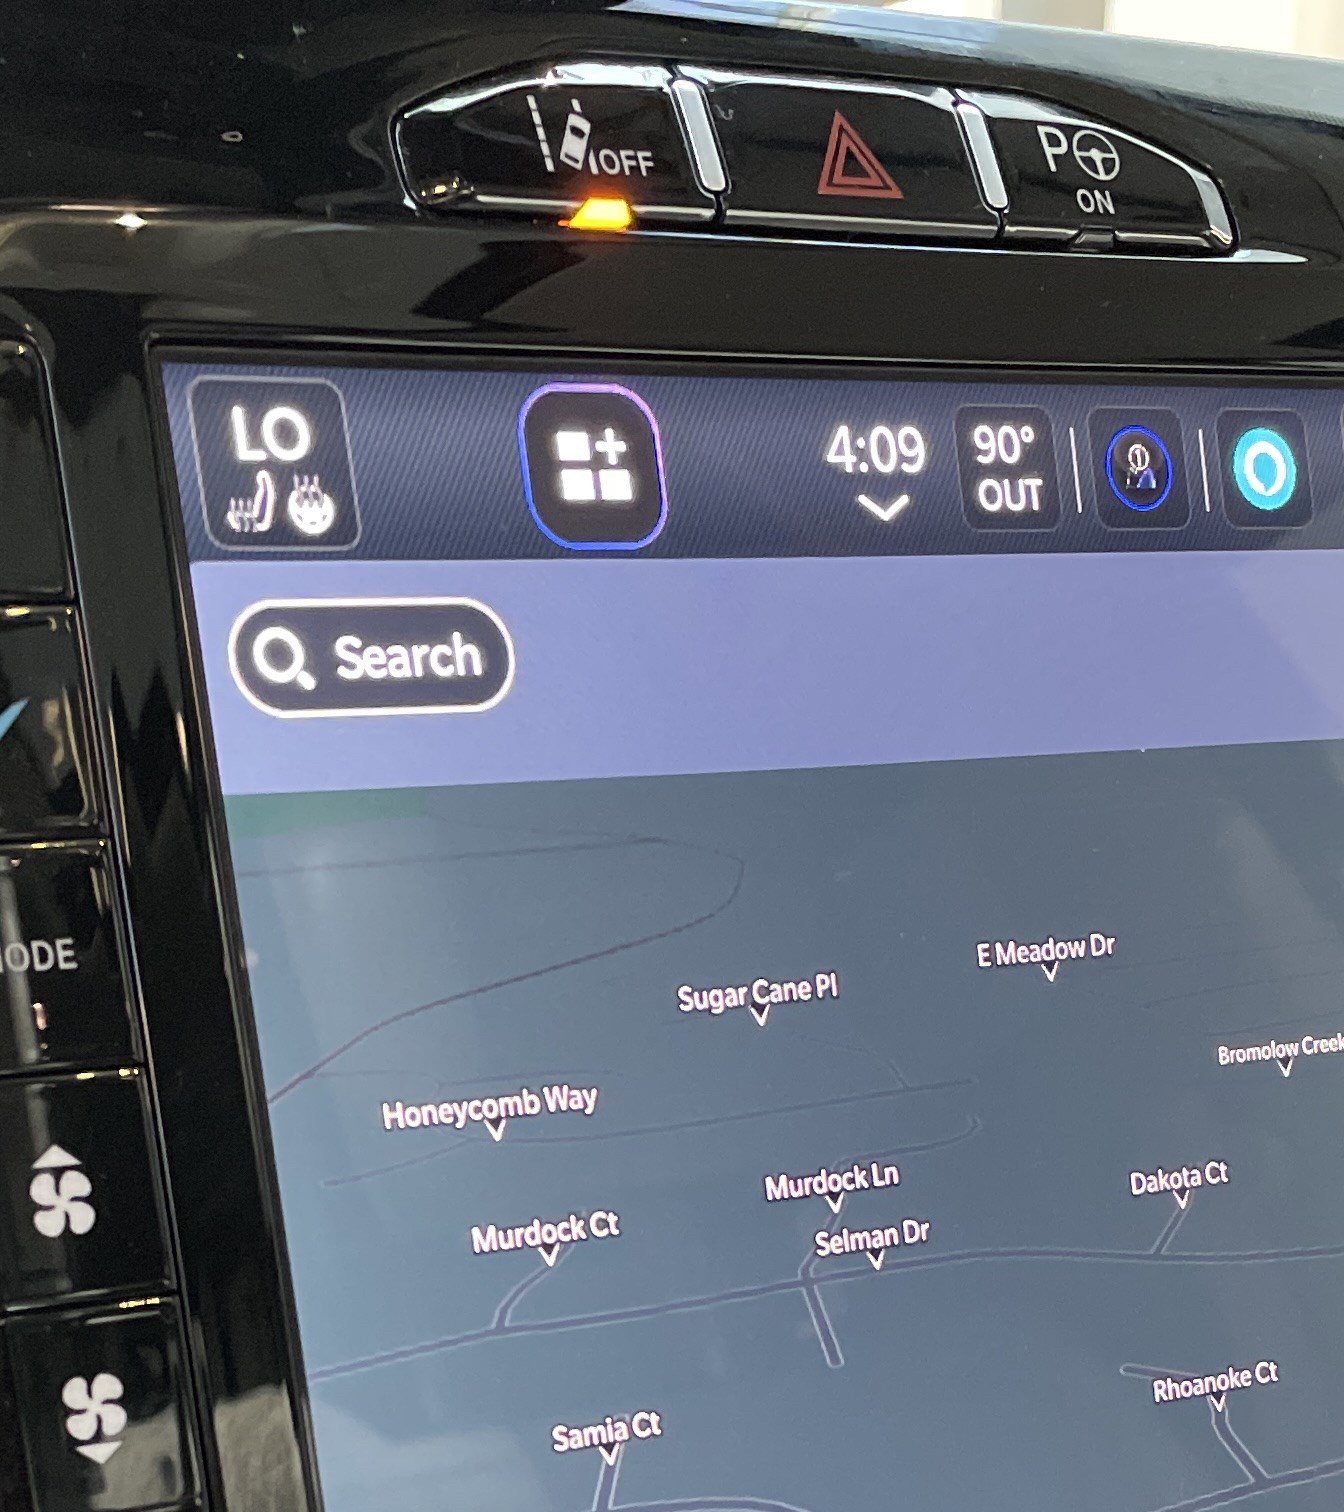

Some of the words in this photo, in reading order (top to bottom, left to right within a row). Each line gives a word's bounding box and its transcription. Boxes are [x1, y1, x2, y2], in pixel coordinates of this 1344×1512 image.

[598, 149, 654, 177] OFF
[1077, 189, 1115, 214] ON
[231, 405, 312, 463] LO
[827, 426, 926, 473] 4:09
[973, 426, 1034, 465] 90°
[979, 478, 1043, 512] OUT
[335, 632, 482, 680] Search
[977, 943, 992, 968] E
[995, 937, 1086, 965] Meadow
[1089, 933, 1116, 957] Dr
[678, 985, 748, 1014] Sugar
[752, 978, 812, 1004] Cane
[815, 972, 839, 998] Pl
[1218, 1039, 1299, 1066] Bromolow
[382, 1089, 541, 1129] Honeycomb
[543, 1085, 597, 1115] Way
[765, 1165, 869, 1201] Murdock
[871, 1162, 900, 1188] Ln
[1130, 1166, 1202, 1196] Dakota
[1204, 1160, 1229, 1185] Ct
[471, 1215, 587, 1253] Murdock
[589, 1211, 620, 1237] Ct
[814, 1225, 900, 1257] Selman
[902, 1219, 930, 1245] Dr
[1153, 1366, 1252, 1403] Rhoanoke
[1255, 1361, 1279, 1384] Ct
[552, 1417, 629, 1453] Samia
[632, 1411, 663, 1438] Ct
